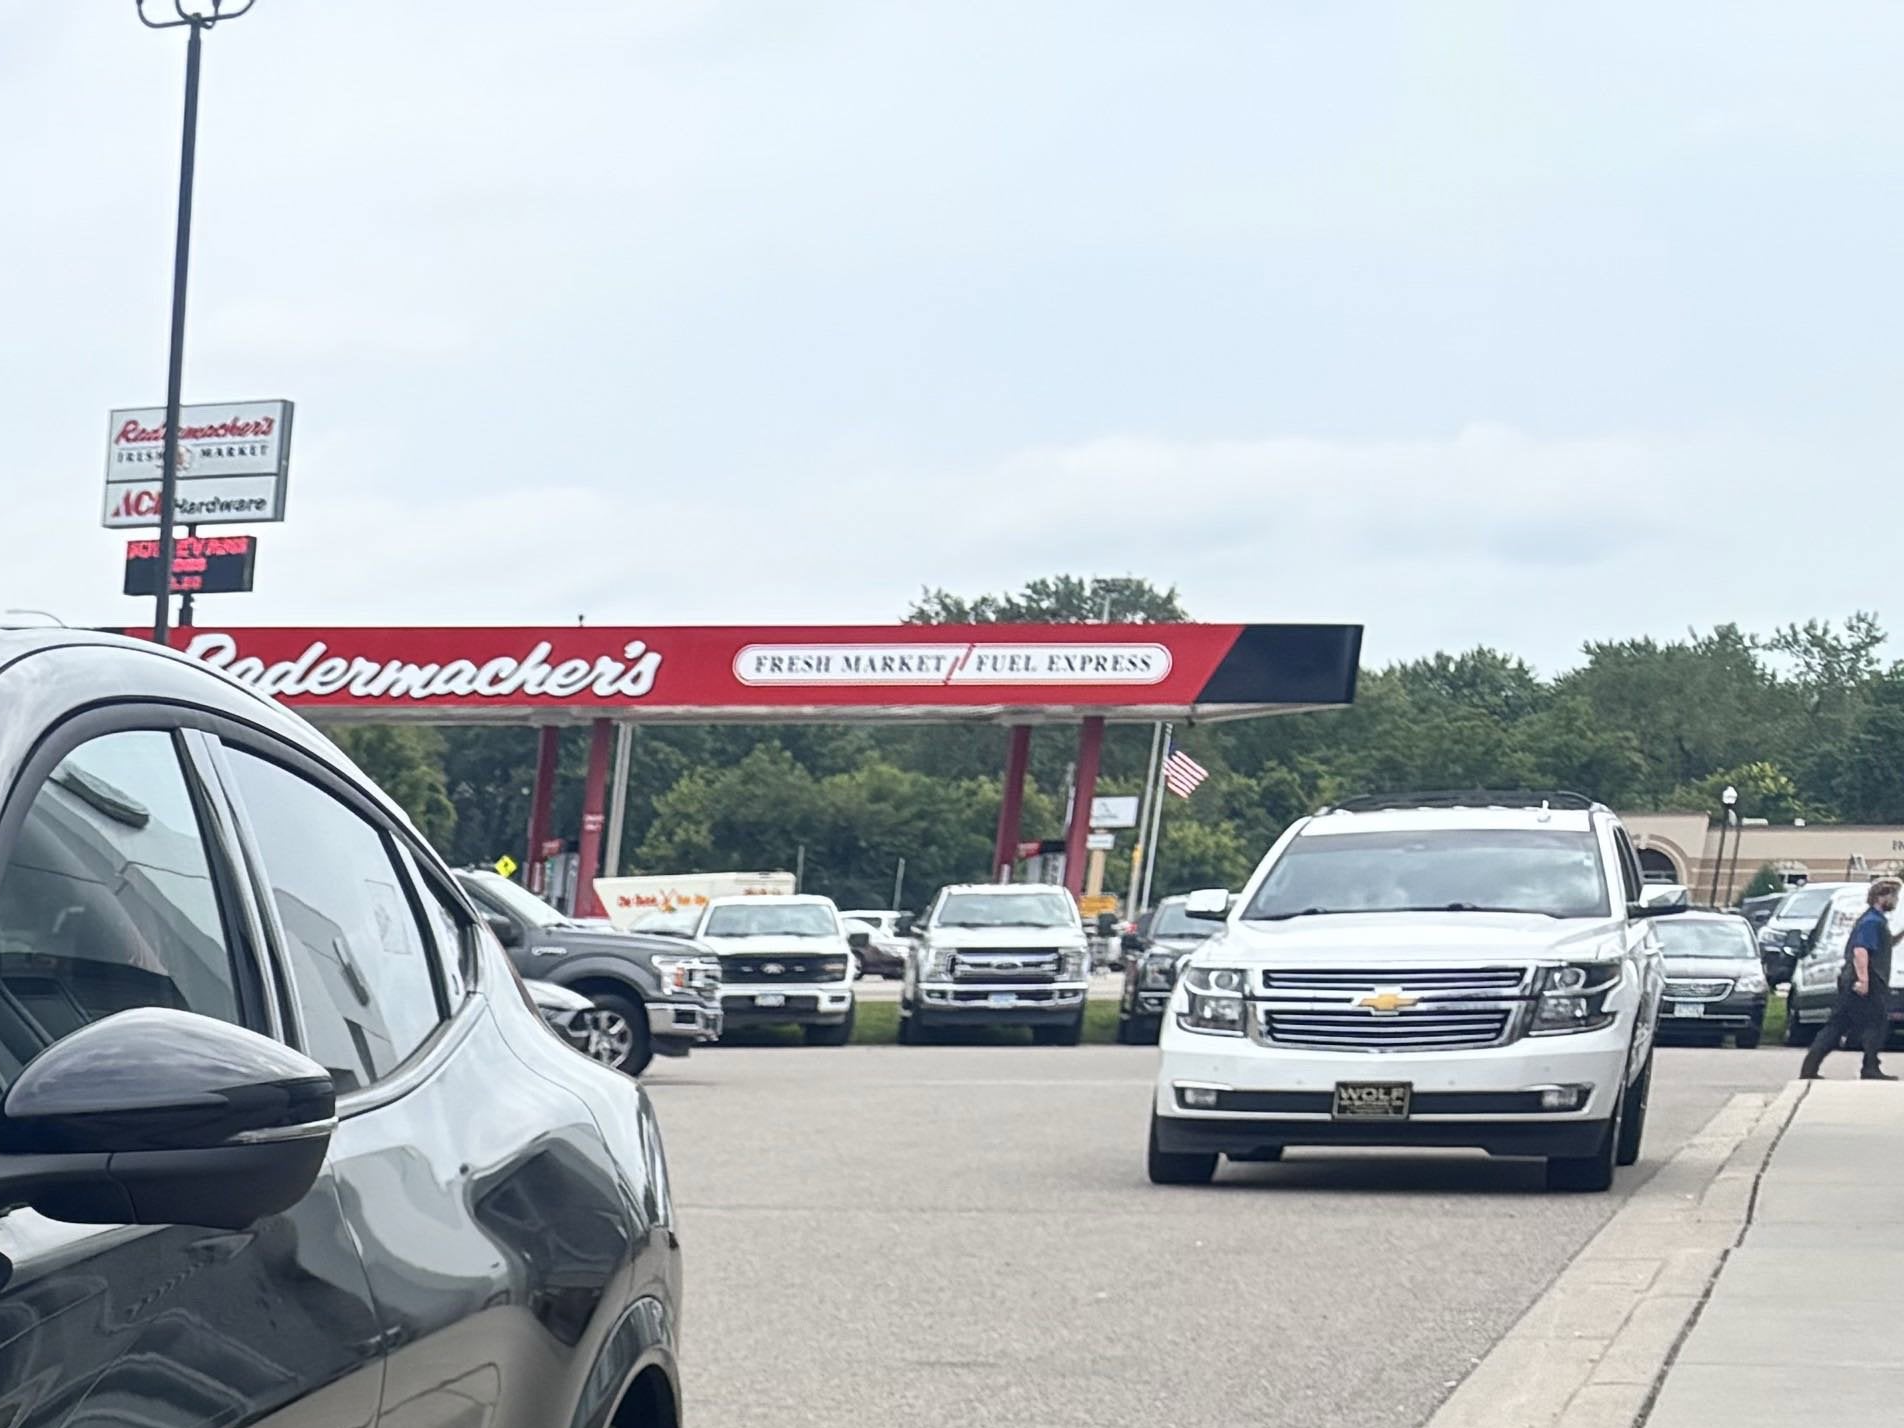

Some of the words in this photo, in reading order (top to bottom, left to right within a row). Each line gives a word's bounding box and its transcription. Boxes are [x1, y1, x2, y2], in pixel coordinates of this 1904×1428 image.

[200, 445, 269, 458] MARKET
[754, 654, 832, 673] FRESH
[840, 654, 948, 673] MARKET
[975, 653, 1038, 672] FUEL
[1046, 653, 1153, 673] EXPRESS
[1339, 1087, 1404, 1101] WOLF
